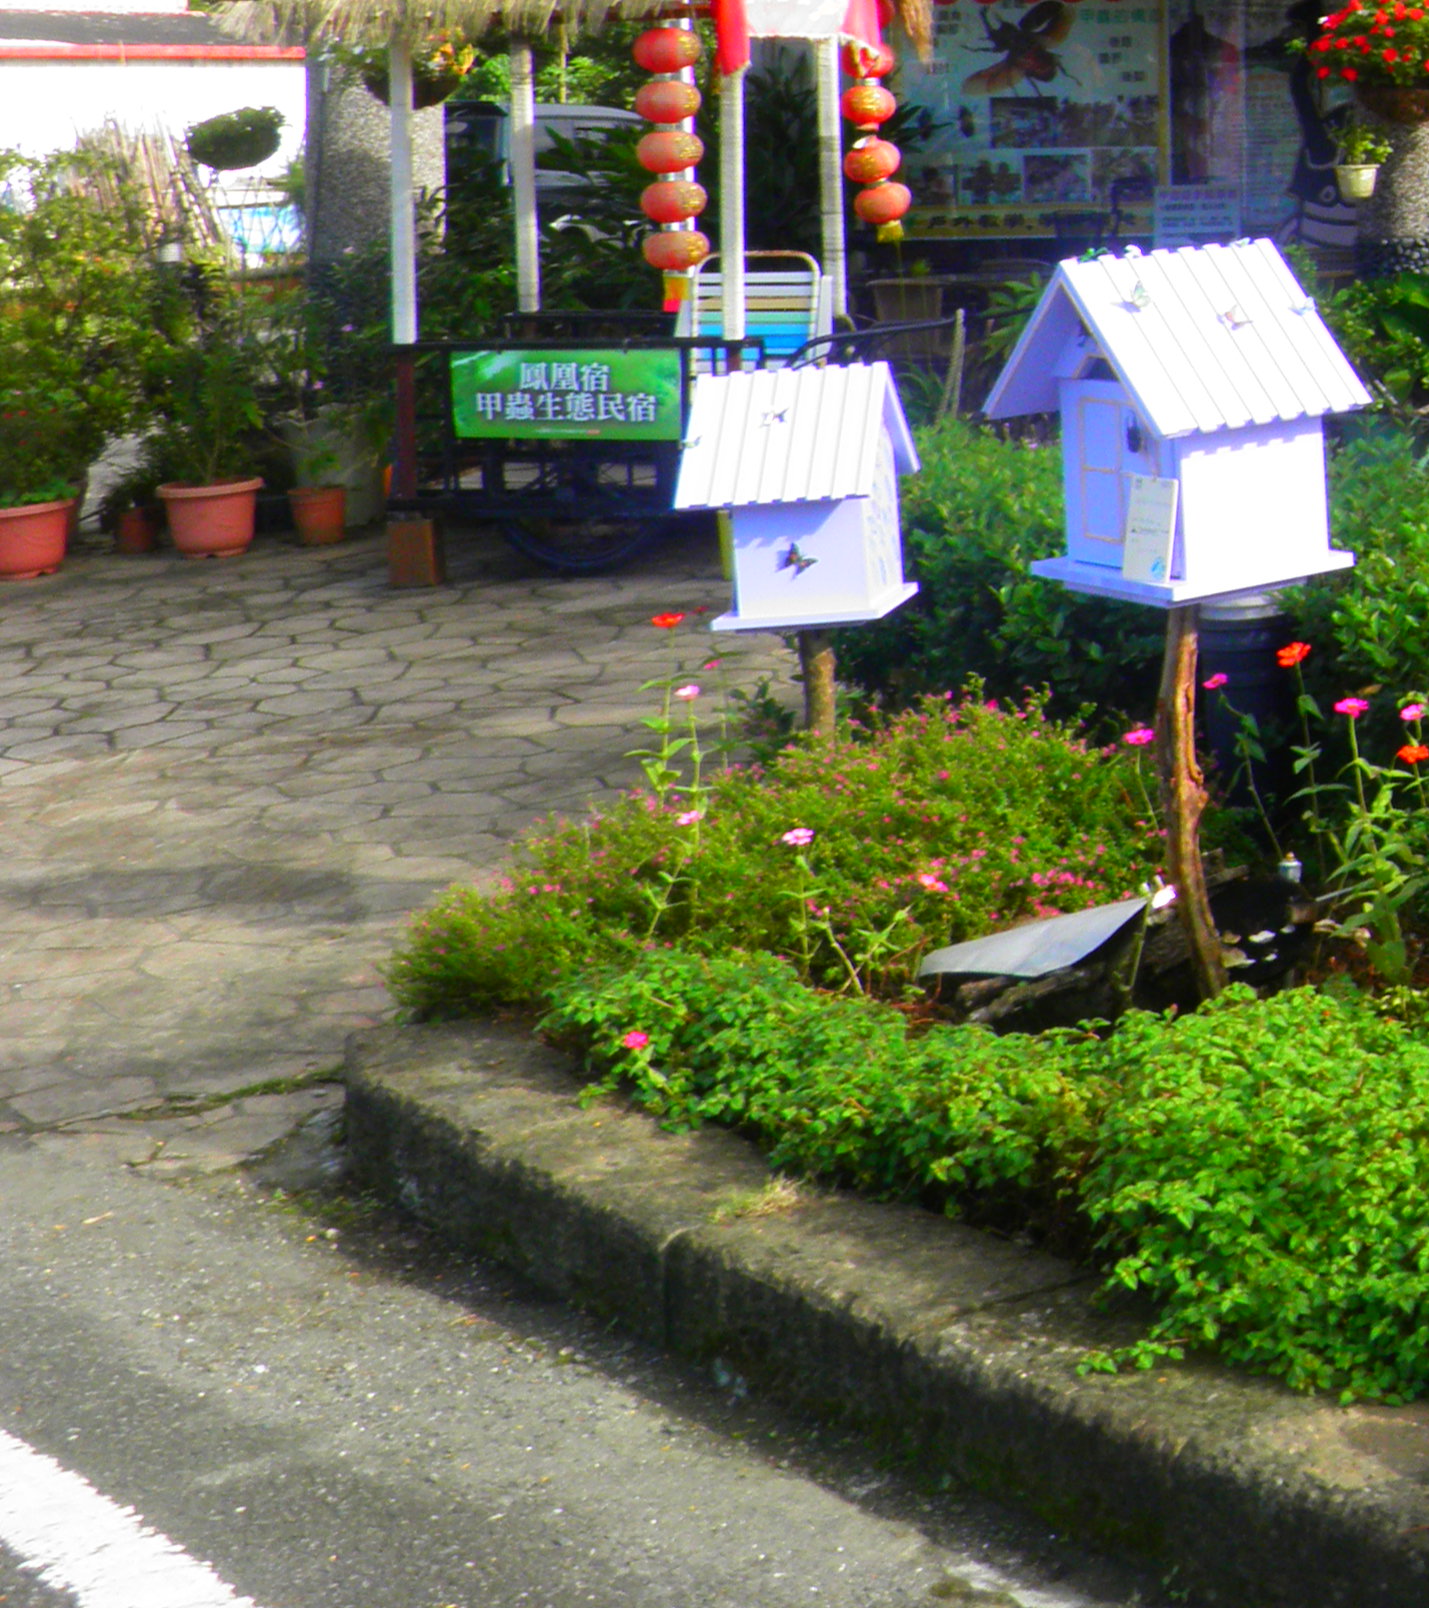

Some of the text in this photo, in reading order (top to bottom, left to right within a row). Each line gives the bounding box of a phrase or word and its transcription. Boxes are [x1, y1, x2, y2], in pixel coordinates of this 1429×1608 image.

[520, 362, 611, 391] 鳳凰宿
[475, 392, 657, 422] 甲蟲生態民宿
